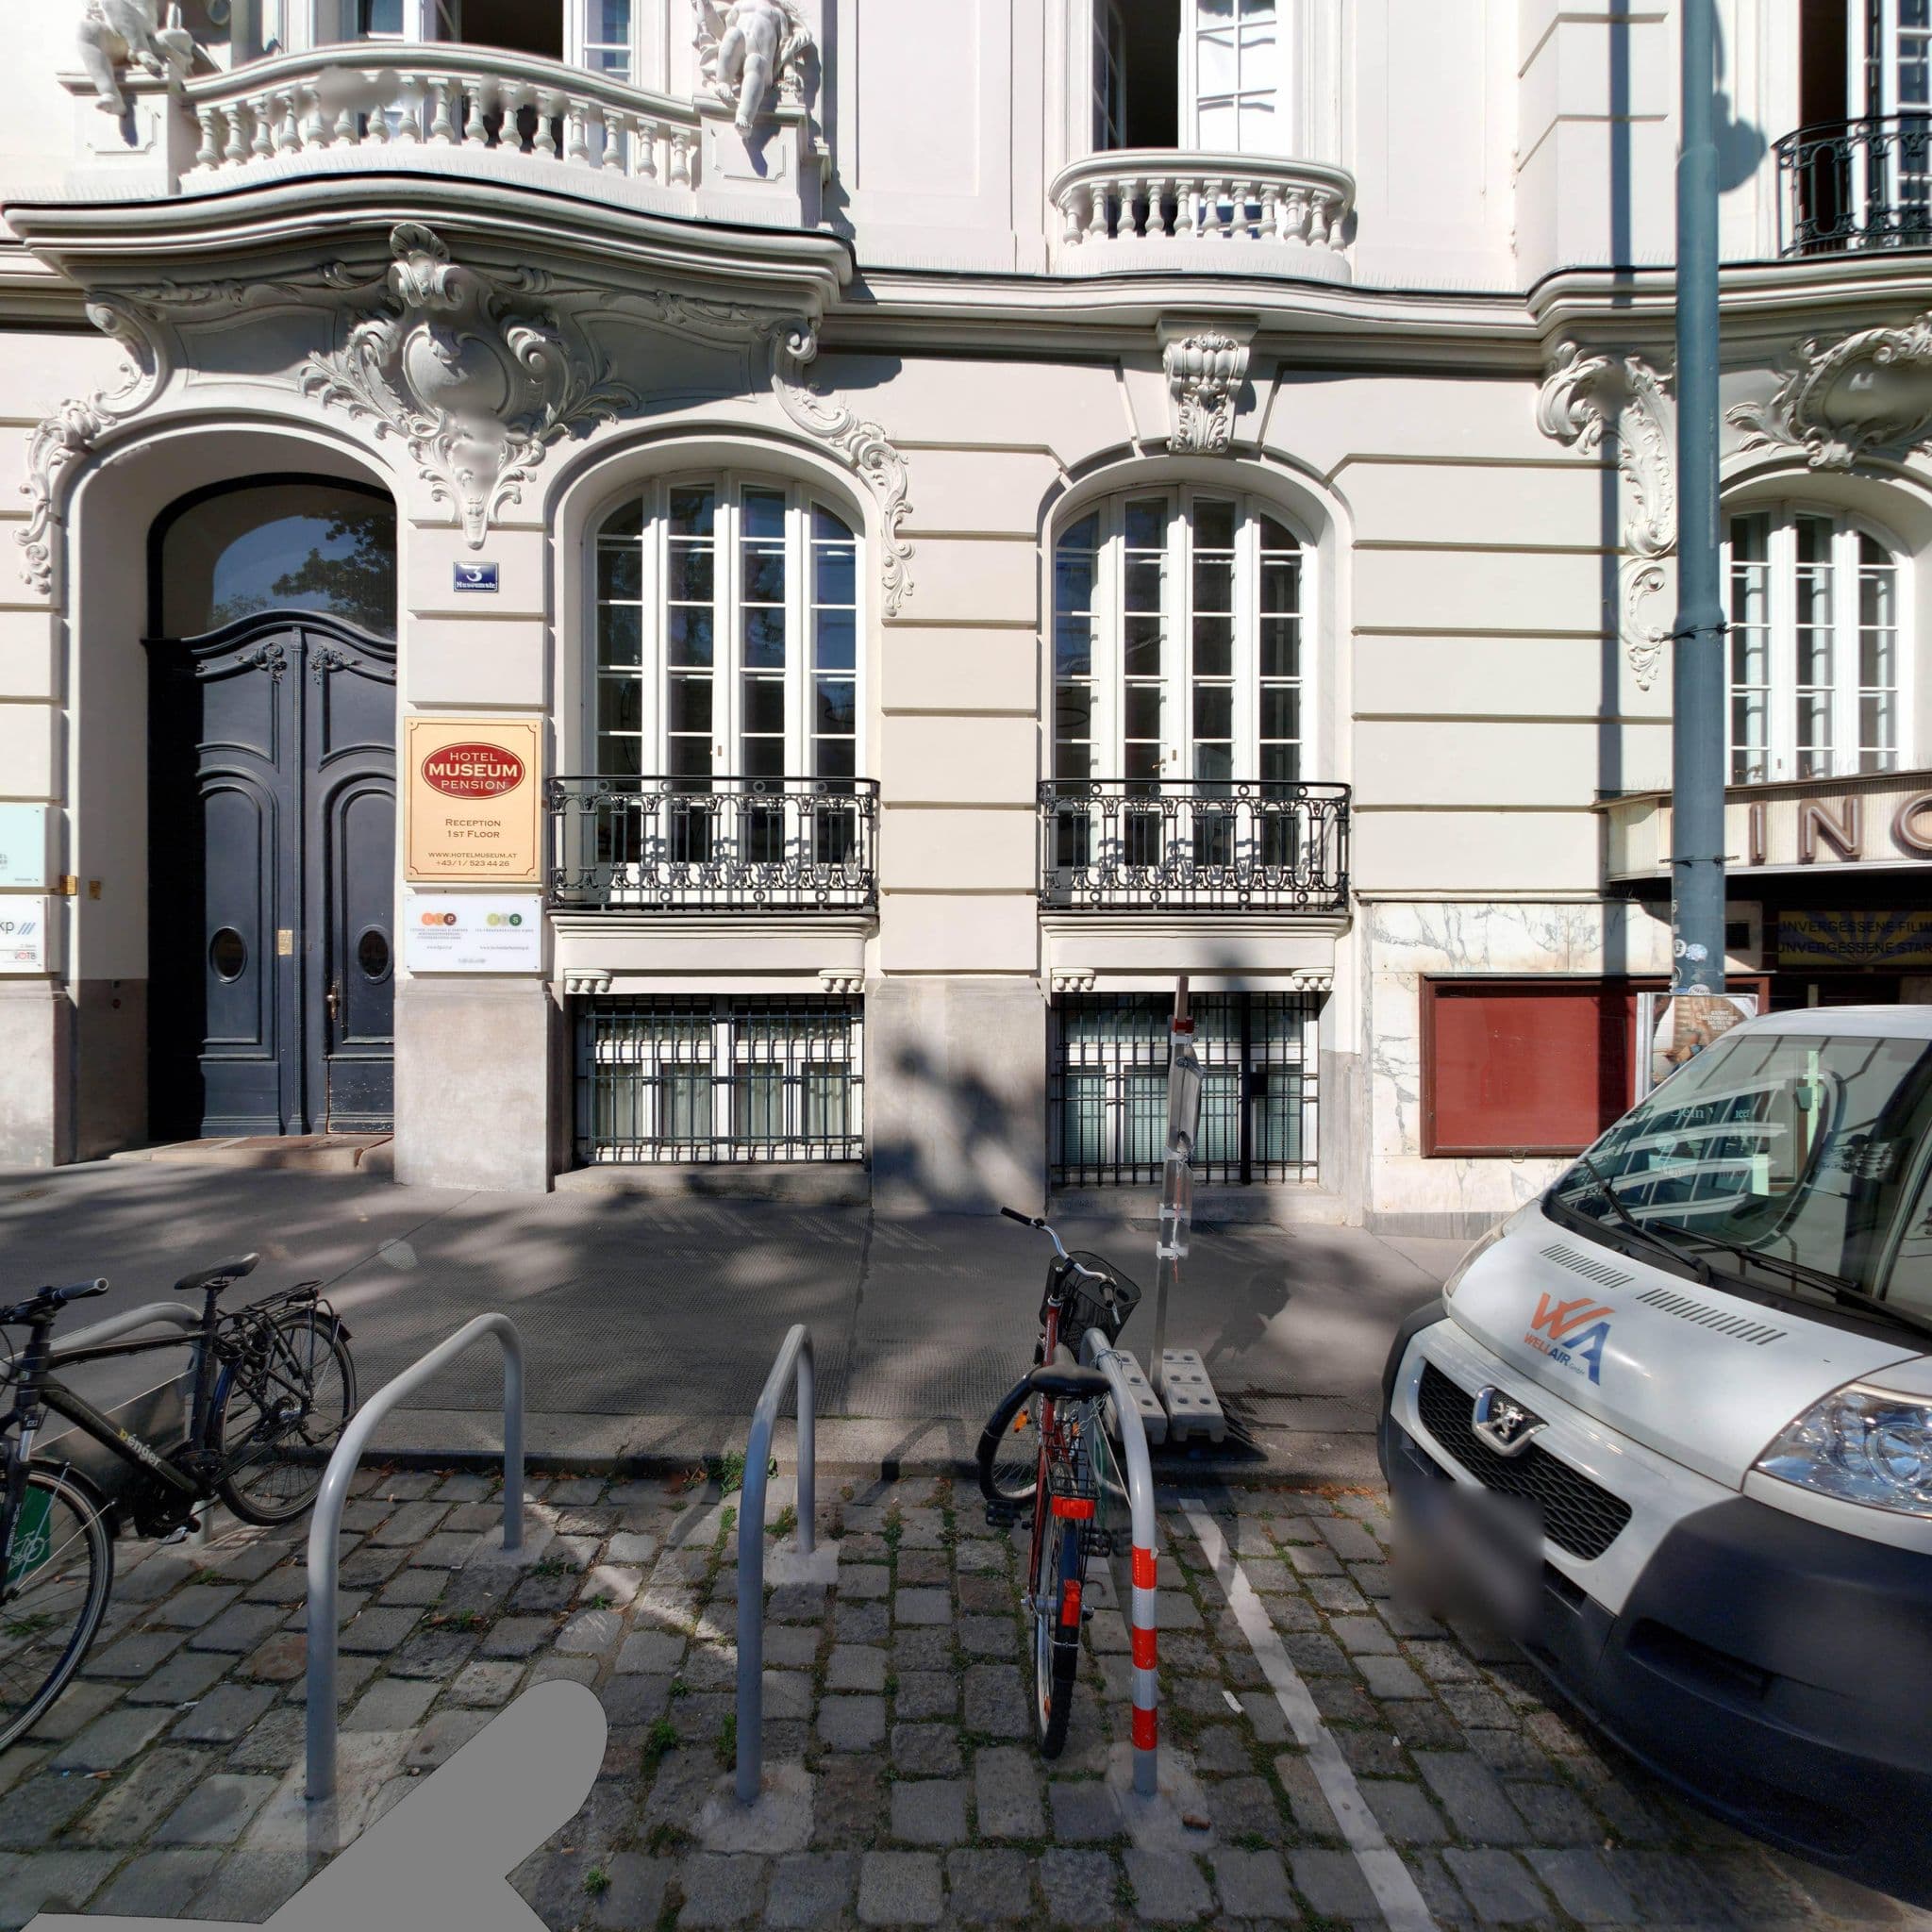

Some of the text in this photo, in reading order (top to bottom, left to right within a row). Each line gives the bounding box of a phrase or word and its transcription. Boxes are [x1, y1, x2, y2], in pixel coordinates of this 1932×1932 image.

[463, 565, 482, 582] 3
[450, 752, 498, 762] HOTEL
[428, 763, 518, 777] MUSEUM
[441, 780, 506, 790] PENSION
[445, 818, 501, 827] RECEPTION
[467, 830, 500, 839] FLOOR
